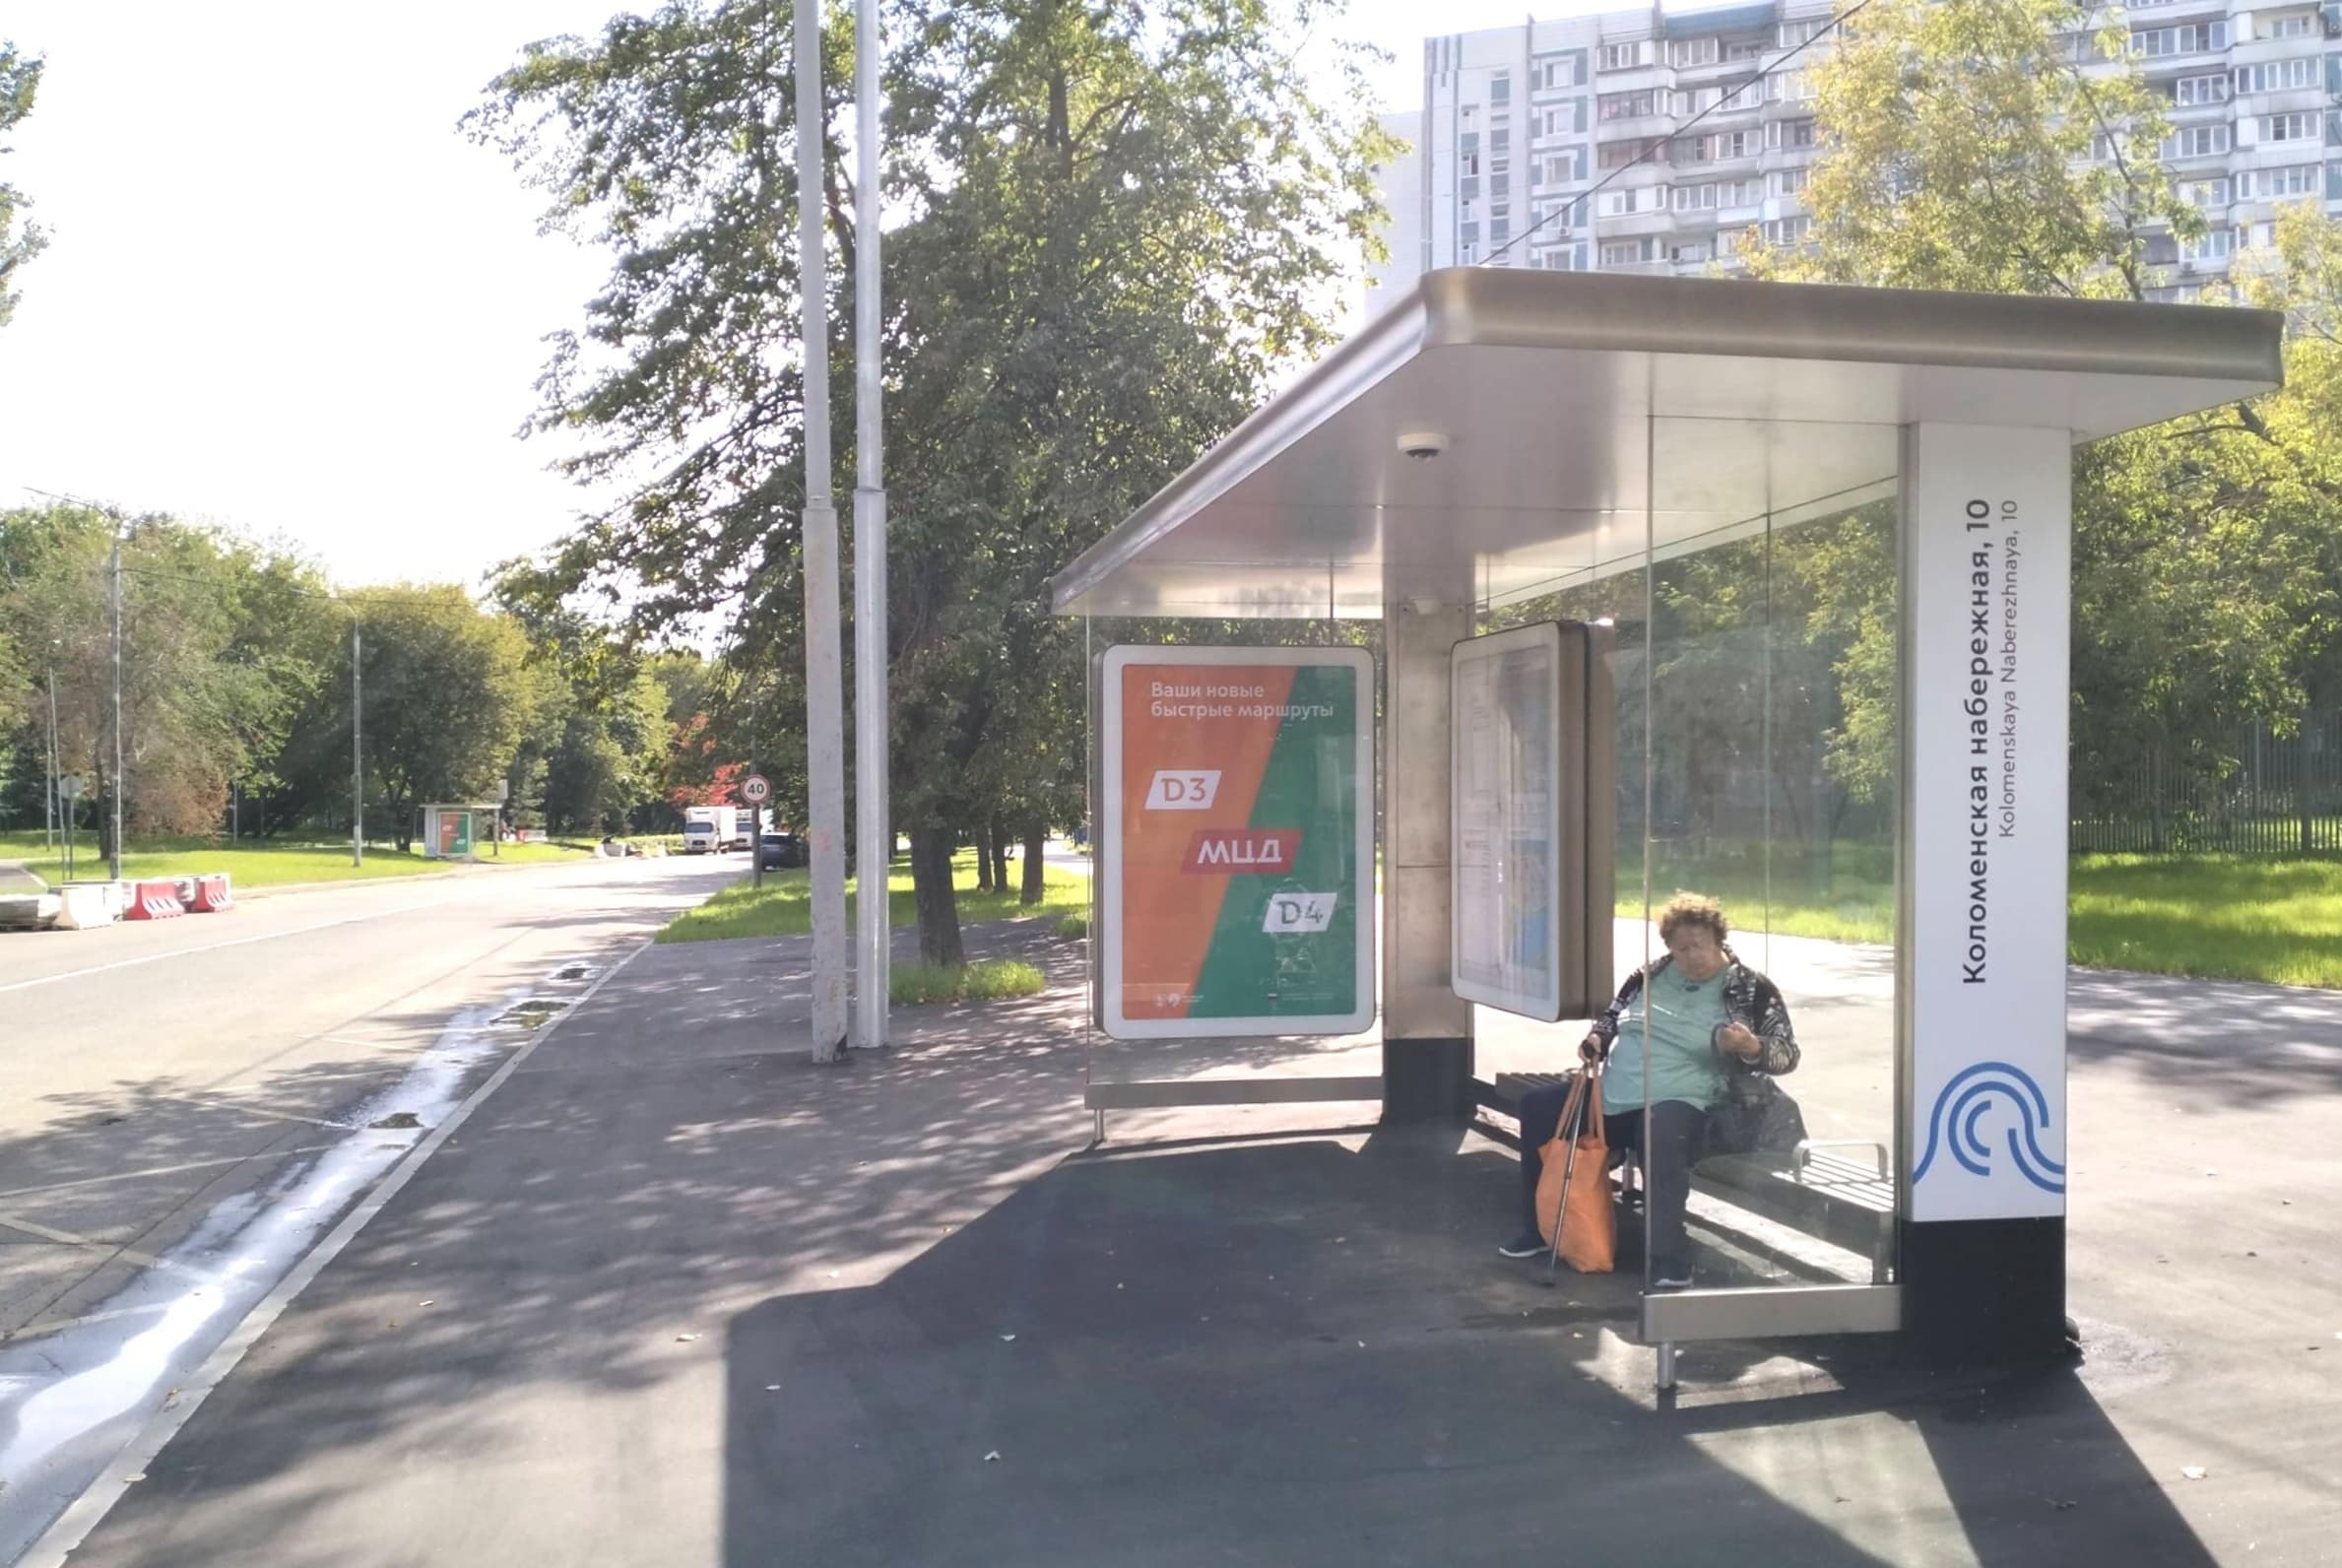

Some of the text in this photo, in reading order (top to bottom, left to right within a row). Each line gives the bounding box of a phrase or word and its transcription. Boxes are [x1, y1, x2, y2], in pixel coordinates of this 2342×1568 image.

[1998, 499, 2021, 837] Kolomenskaya Naberezhnaya, 10
[1150, 681, 1265, 697] Ваши новые
[1150, 700, 1334, 721] быстрые маршруты
[1963, 498, 1993, 983] Коломенская набережная, 10
[748, 783, 764, 795] 40
[1161, 777, 1206, 803] D3
[1197, 839, 1283, 865] МЦД
[1278, 900, 1324, 924] D4
